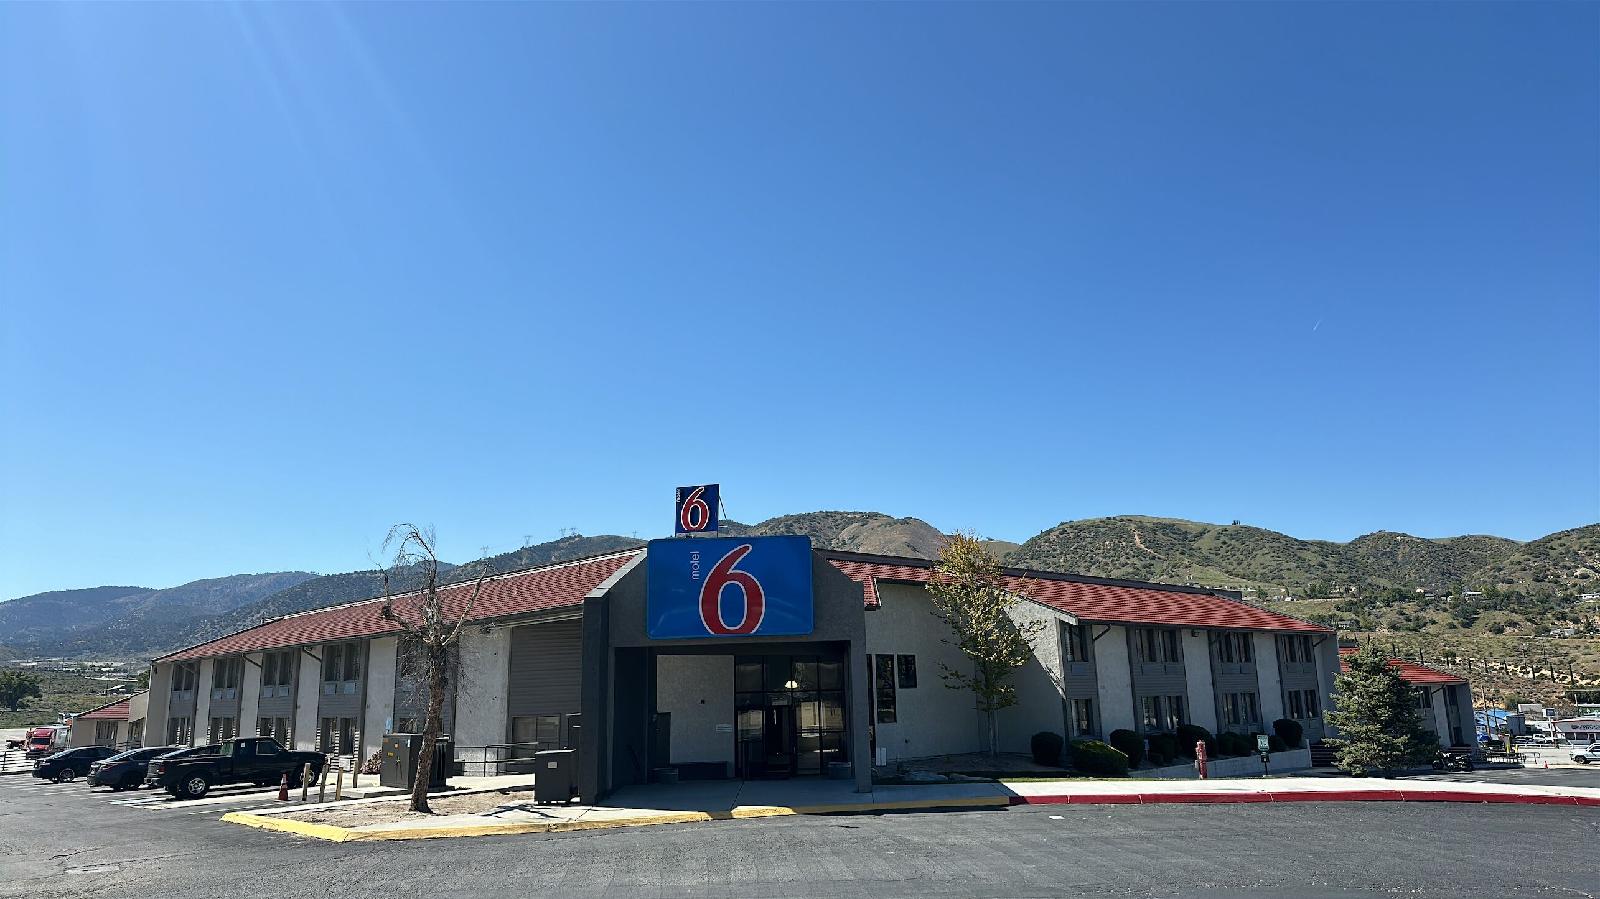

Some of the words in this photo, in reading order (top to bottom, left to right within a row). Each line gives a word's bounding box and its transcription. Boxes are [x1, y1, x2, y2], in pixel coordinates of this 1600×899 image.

[681, 487, 709, 530] 6
[690, 551, 699, 580] motel
[699, 544, 765, 634] 6
